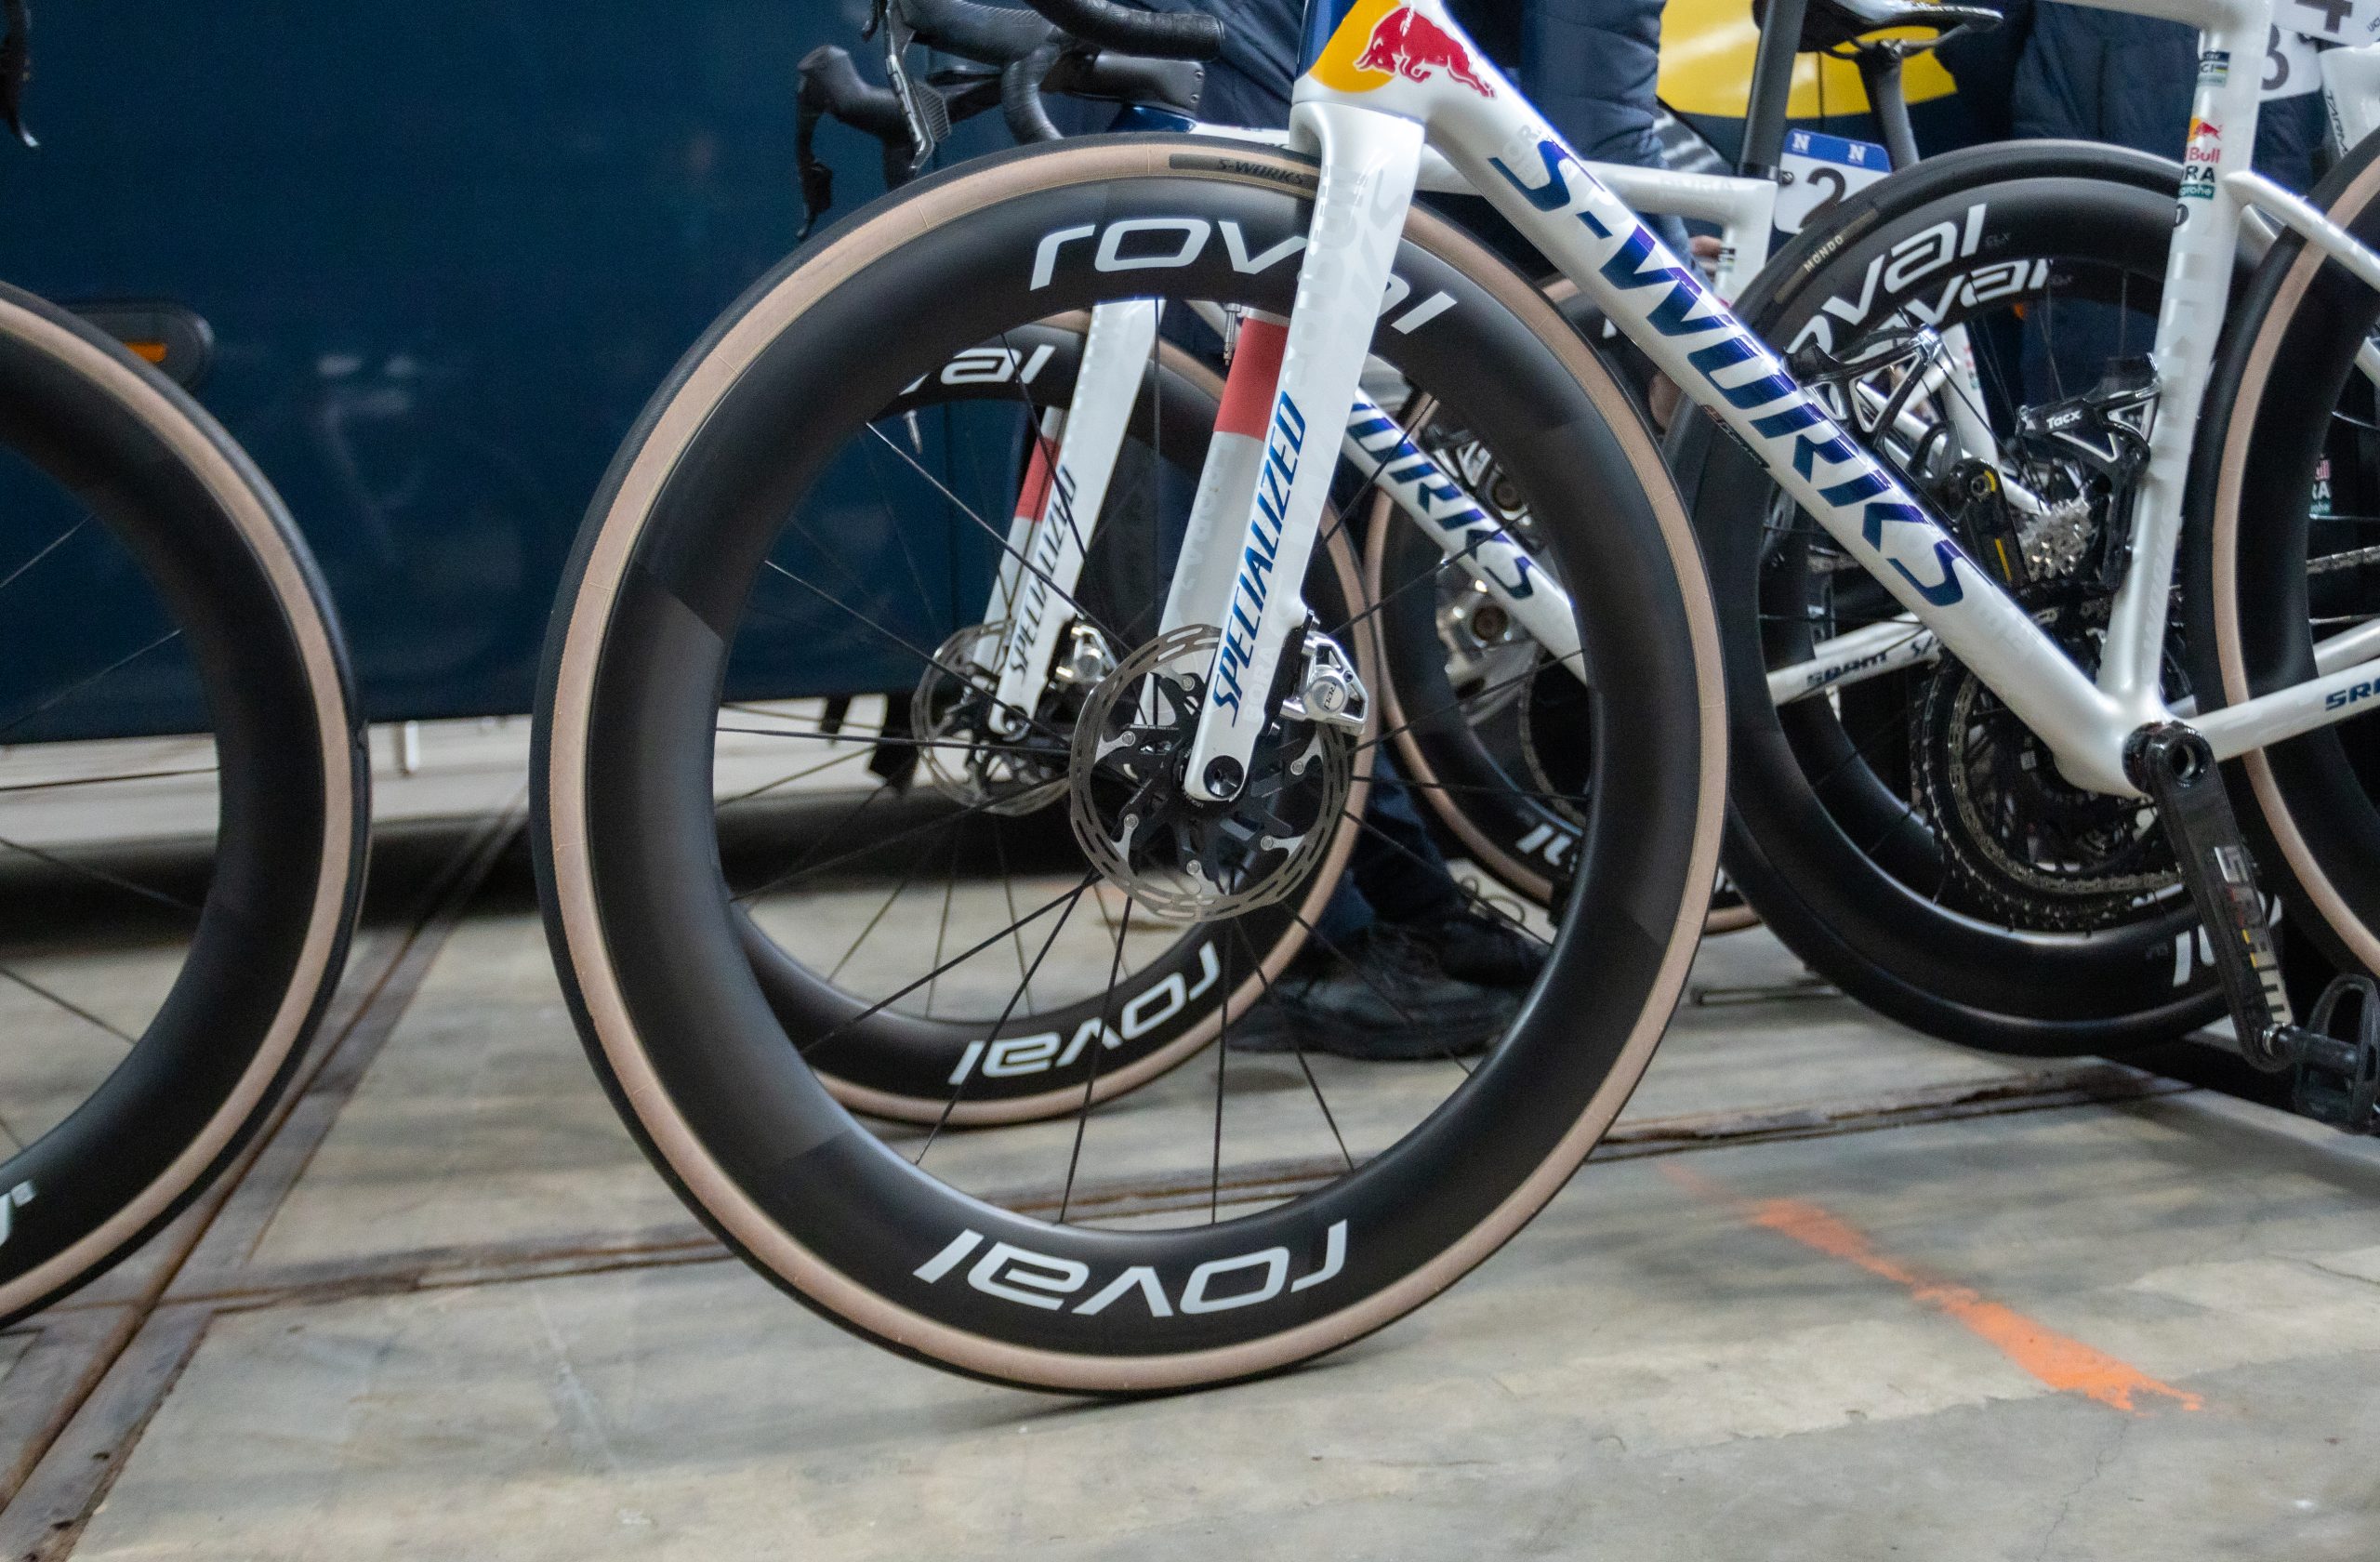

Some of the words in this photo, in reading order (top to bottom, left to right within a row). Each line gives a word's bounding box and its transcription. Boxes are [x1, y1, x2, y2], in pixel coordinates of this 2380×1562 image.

[1219, 158, 1303, 186] S-WORKS
[1799, 167, 1846, 231] 2
[2188, 147, 2221, 165] Bull
[1030, 218, 1458, 335] rovl
[1803, 234, 1844, 272] MONDO
[1488, 139, 1964, 607] S-WORKS
[2046, 410, 2082, 429] Tacx
[1346, 402, 1534, 601] ORKS
[1010, 464, 1077, 684] SPECIALIZED
[1212, 390, 1305, 728] SPECIALIZED
[2326, 677, 2380, 711] SR
[948, 941, 1220, 1085] roval
[913, 1219, 1347, 1317] roval
